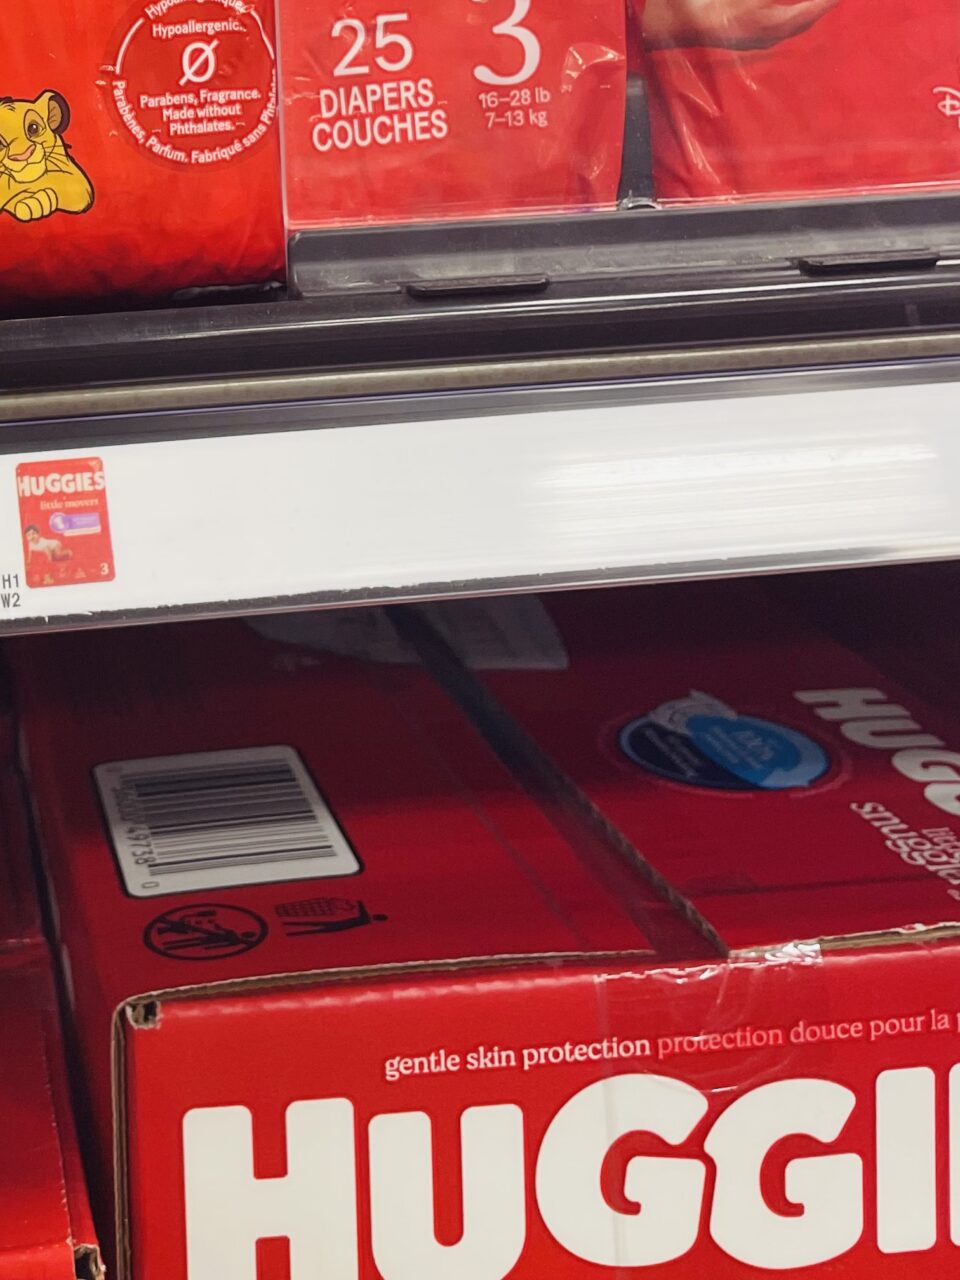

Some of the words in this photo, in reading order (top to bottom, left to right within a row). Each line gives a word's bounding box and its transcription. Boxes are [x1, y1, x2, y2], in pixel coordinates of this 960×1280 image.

[331, 12, 413, 77] 25
[140, 93, 198, 108] Parabens,
[200, 89, 262, 105] Fragrance.
[319, 78, 434, 119] DIAPERS
[534, 87, 551, 104] lb
[162, 107, 195, 121] Made
[196, 104, 241, 118] without
[528, 109, 549, 128] kg
[169, 121, 236, 136] Phthalates.
[312, 109, 448, 152] COUCHES
[146, 135, 189, 163] Parfum.
[191, 140, 242, 164] Fabriqué
[242, 123, 268, 148] sans
[17, 471, 105, 498] HUGGIES
[99, 562, 109, 576] 3
[1, 573, 19, 590] H1
[0, 592, 21, 609] W2
[384, 1046, 460, 1083] gentle
[466, 1041, 518, 1070] skin
[522, 1034, 652, 1074] protection
[657, 1025, 784, 1060] protection
[790, 1019, 863, 1045] douce
[870, 1014, 925, 1042] pour
[930, 1007, 950, 1030] la
[182, 1073, 960, 1280] HUGGI
